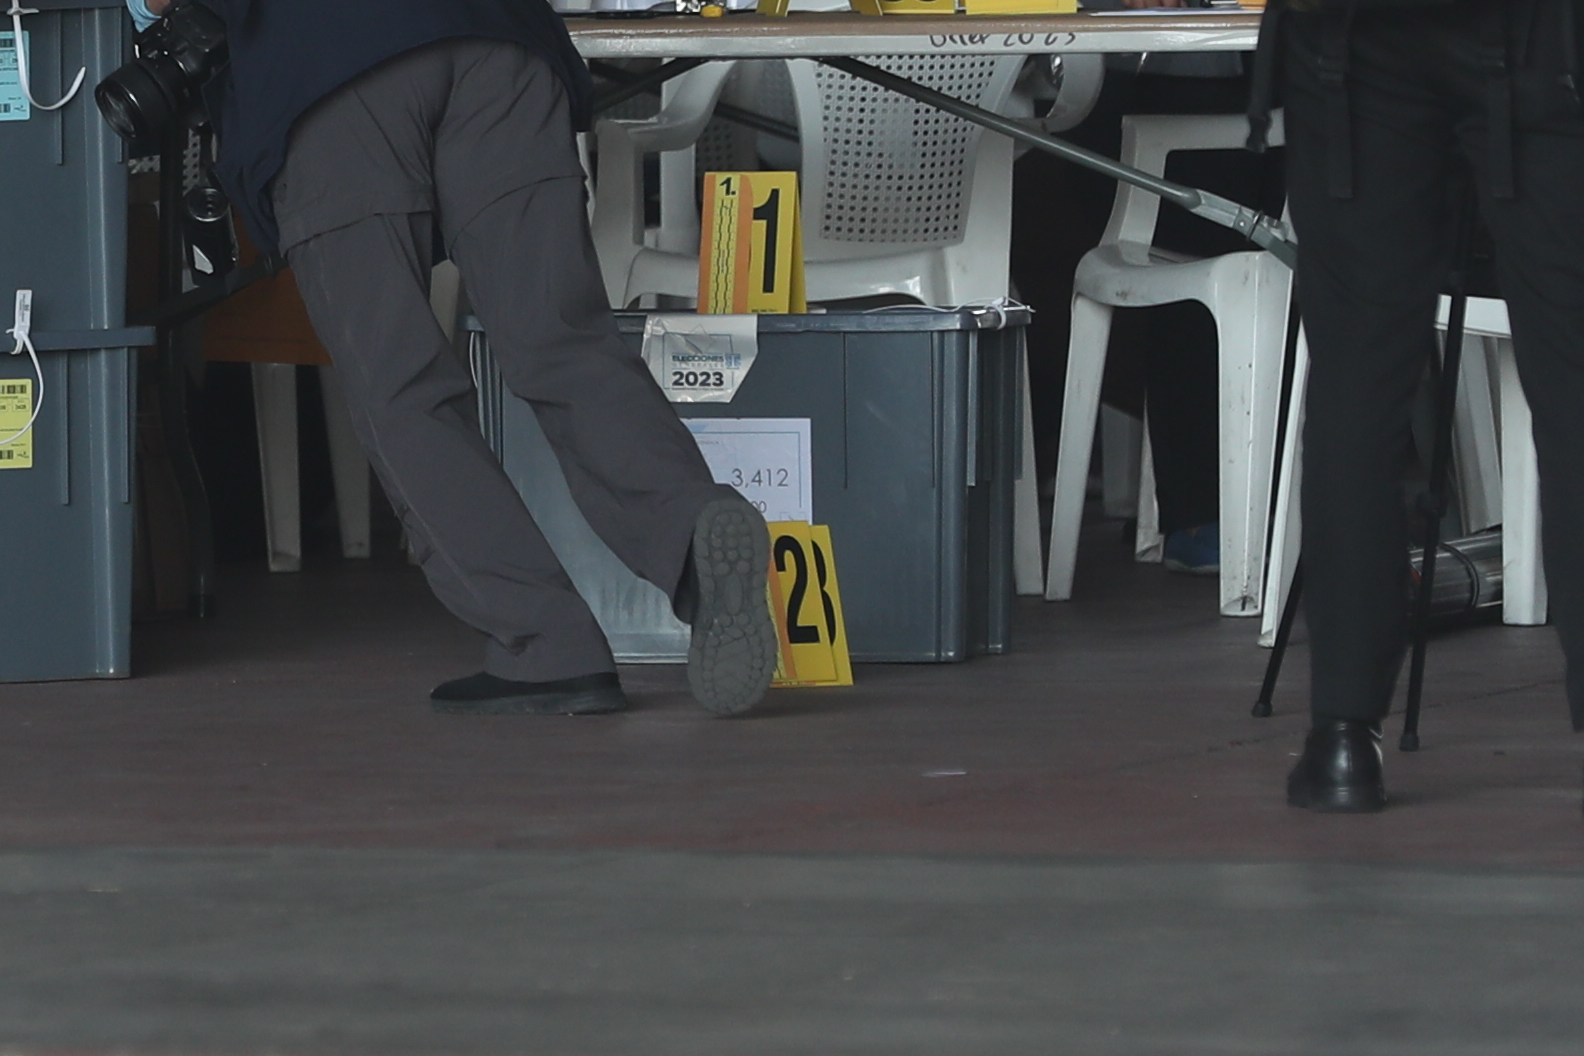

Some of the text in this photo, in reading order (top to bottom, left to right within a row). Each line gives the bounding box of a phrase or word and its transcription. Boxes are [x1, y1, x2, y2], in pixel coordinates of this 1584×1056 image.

[752, 188, 780, 294] 1
[671, 370, 725, 387] 2023
[730, 468, 789, 489] 3,412
[774, 534, 821, 644] 2
